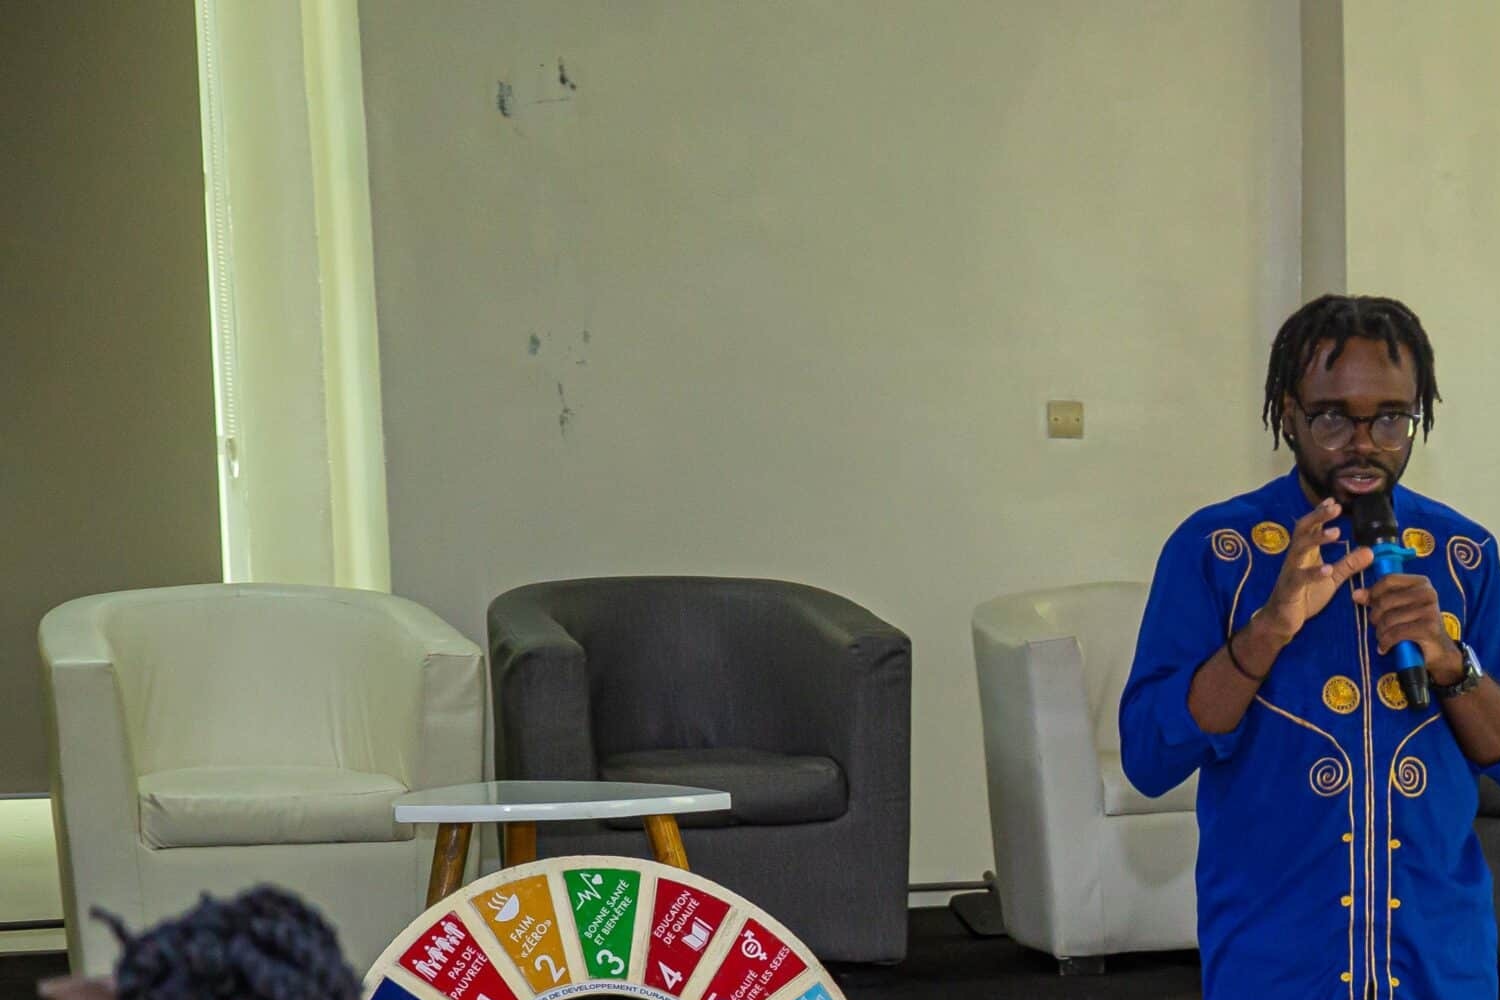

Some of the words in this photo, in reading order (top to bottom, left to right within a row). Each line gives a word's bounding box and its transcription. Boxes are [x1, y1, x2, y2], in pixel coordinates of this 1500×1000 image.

[584, 907, 610, 939] BONNE
[606, 879, 630, 908] SANTÉ
[593, 931, 606, 946] ET
[602, 895, 633, 936] BIEN-ÊTRE
[653, 890, 691, 938] EDUCATION
[663, 933, 675, 945] DE
[673, 898, 700, 933] QUALITÉ
[509, 915, 536, 943] FAIM
[521, 919, 553, 959] «ZÉRO»
[448, 960, 464, 980] PAS
[462, 945, 476, 961] DE
[450, 953, 488, 1000] PAUVRETÉ
[534, 955, 566, 983] 2
[596, 949, 625, 975] 3
[658, 960, 683, 990] 4
[760, 971, 773, 985] LES
[769, 946, 790, 971] SEXES
[549, 992, 561, 1000] DE
[562, 983, 637, 995] DEVELOPPEMENT
